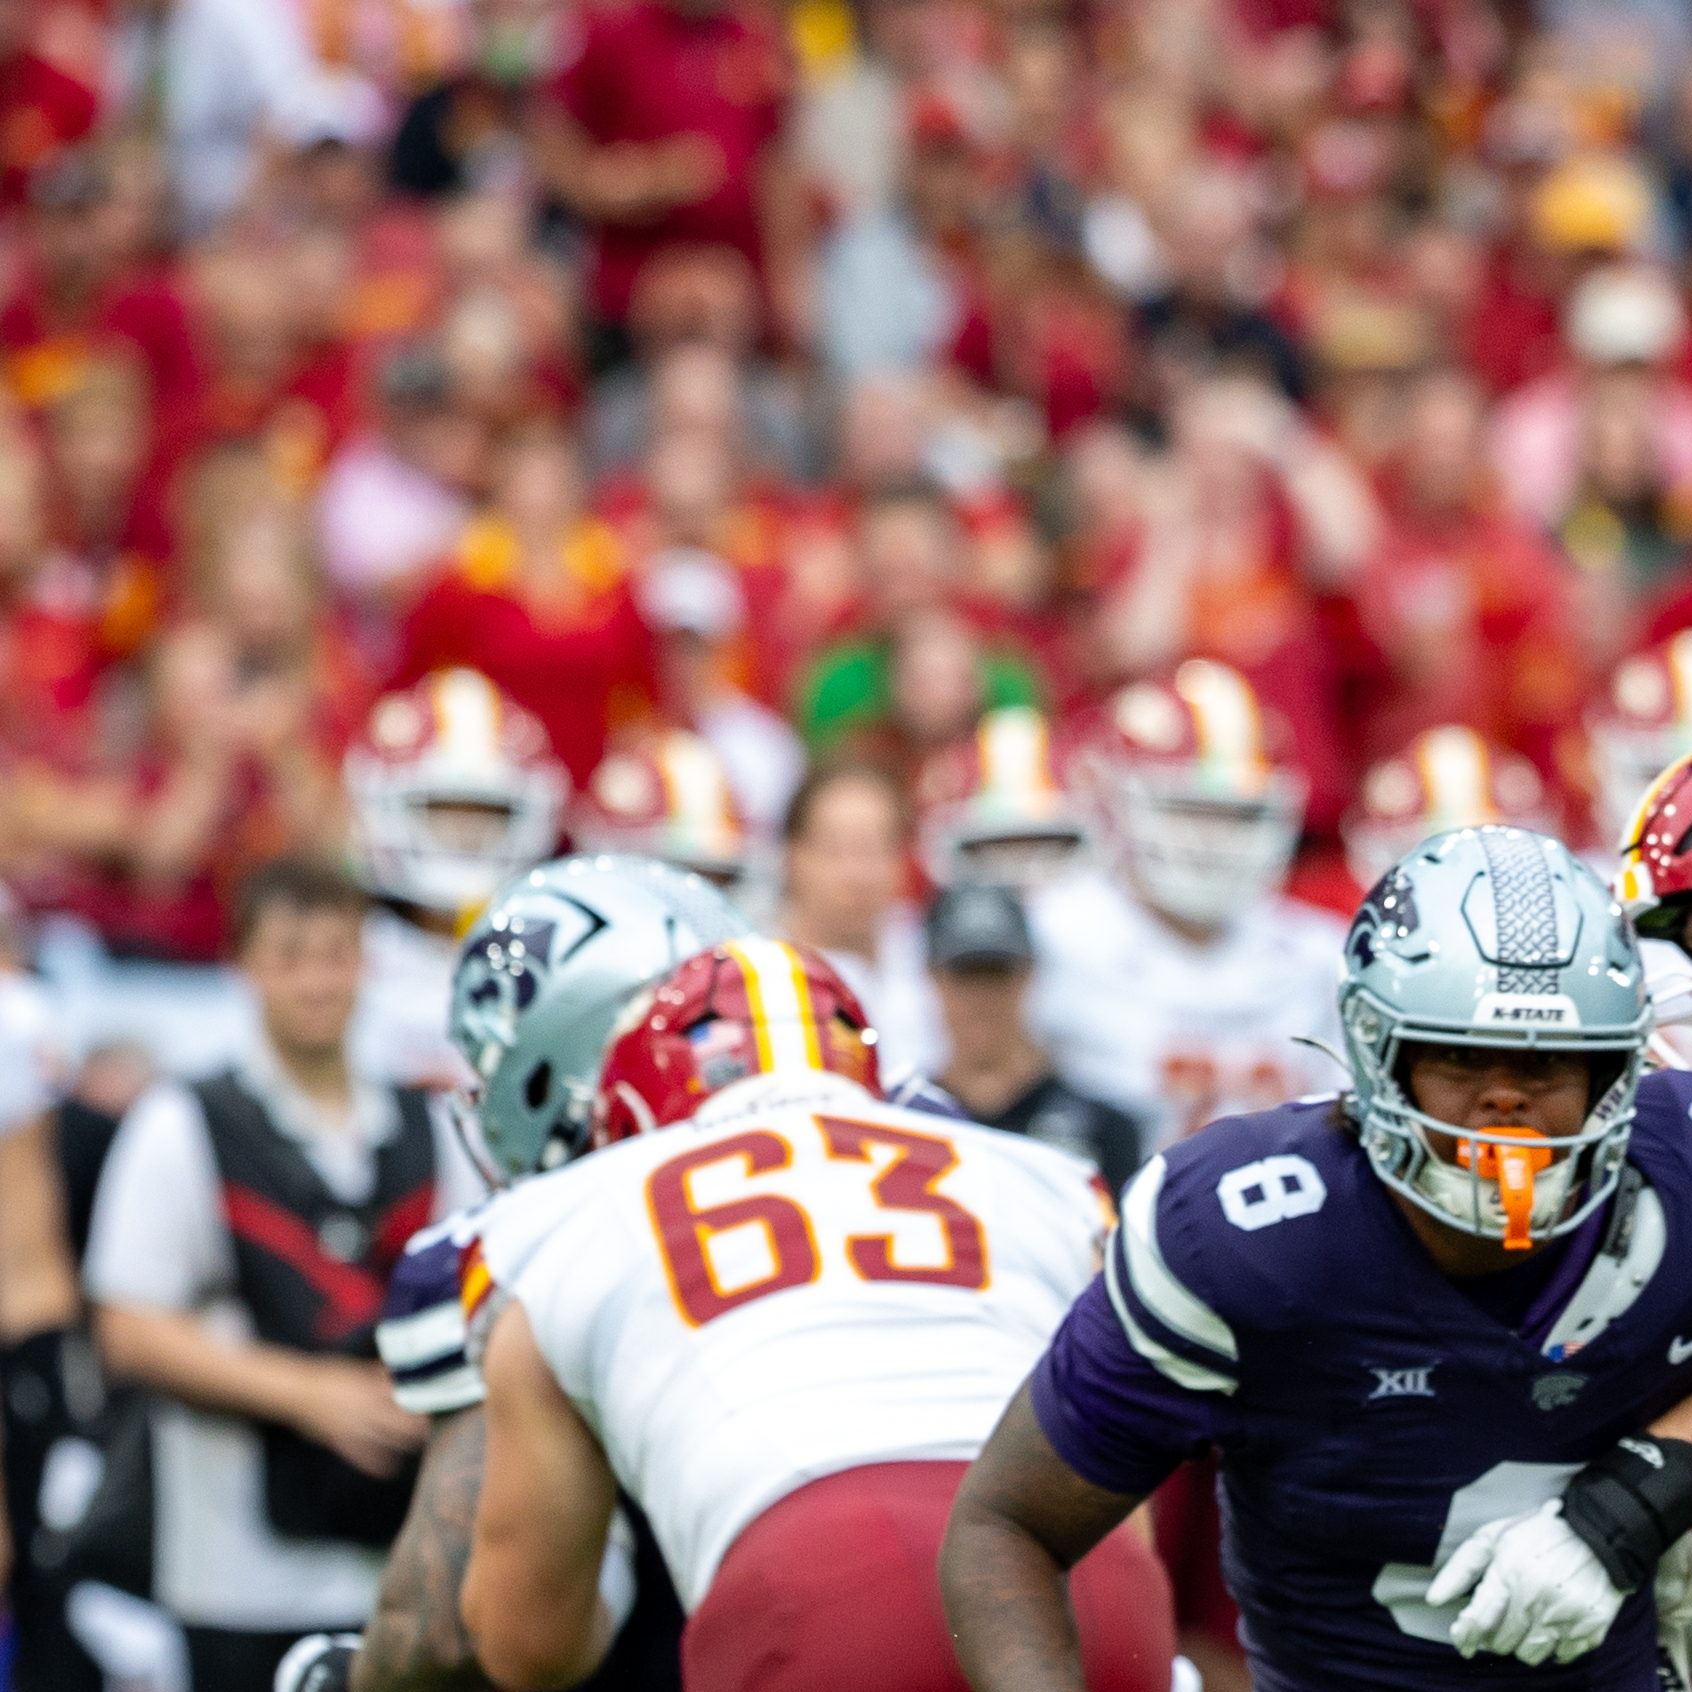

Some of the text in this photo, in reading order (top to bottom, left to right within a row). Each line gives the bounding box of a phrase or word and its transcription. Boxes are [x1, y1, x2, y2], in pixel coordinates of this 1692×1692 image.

[1492, 1007, 1565, 1023] K-STATE
[644, 1114, 991, 1329] 63
[1216, 1154, 1328, 1232] 8
[1368, 1363, 1437, 1400] XII
